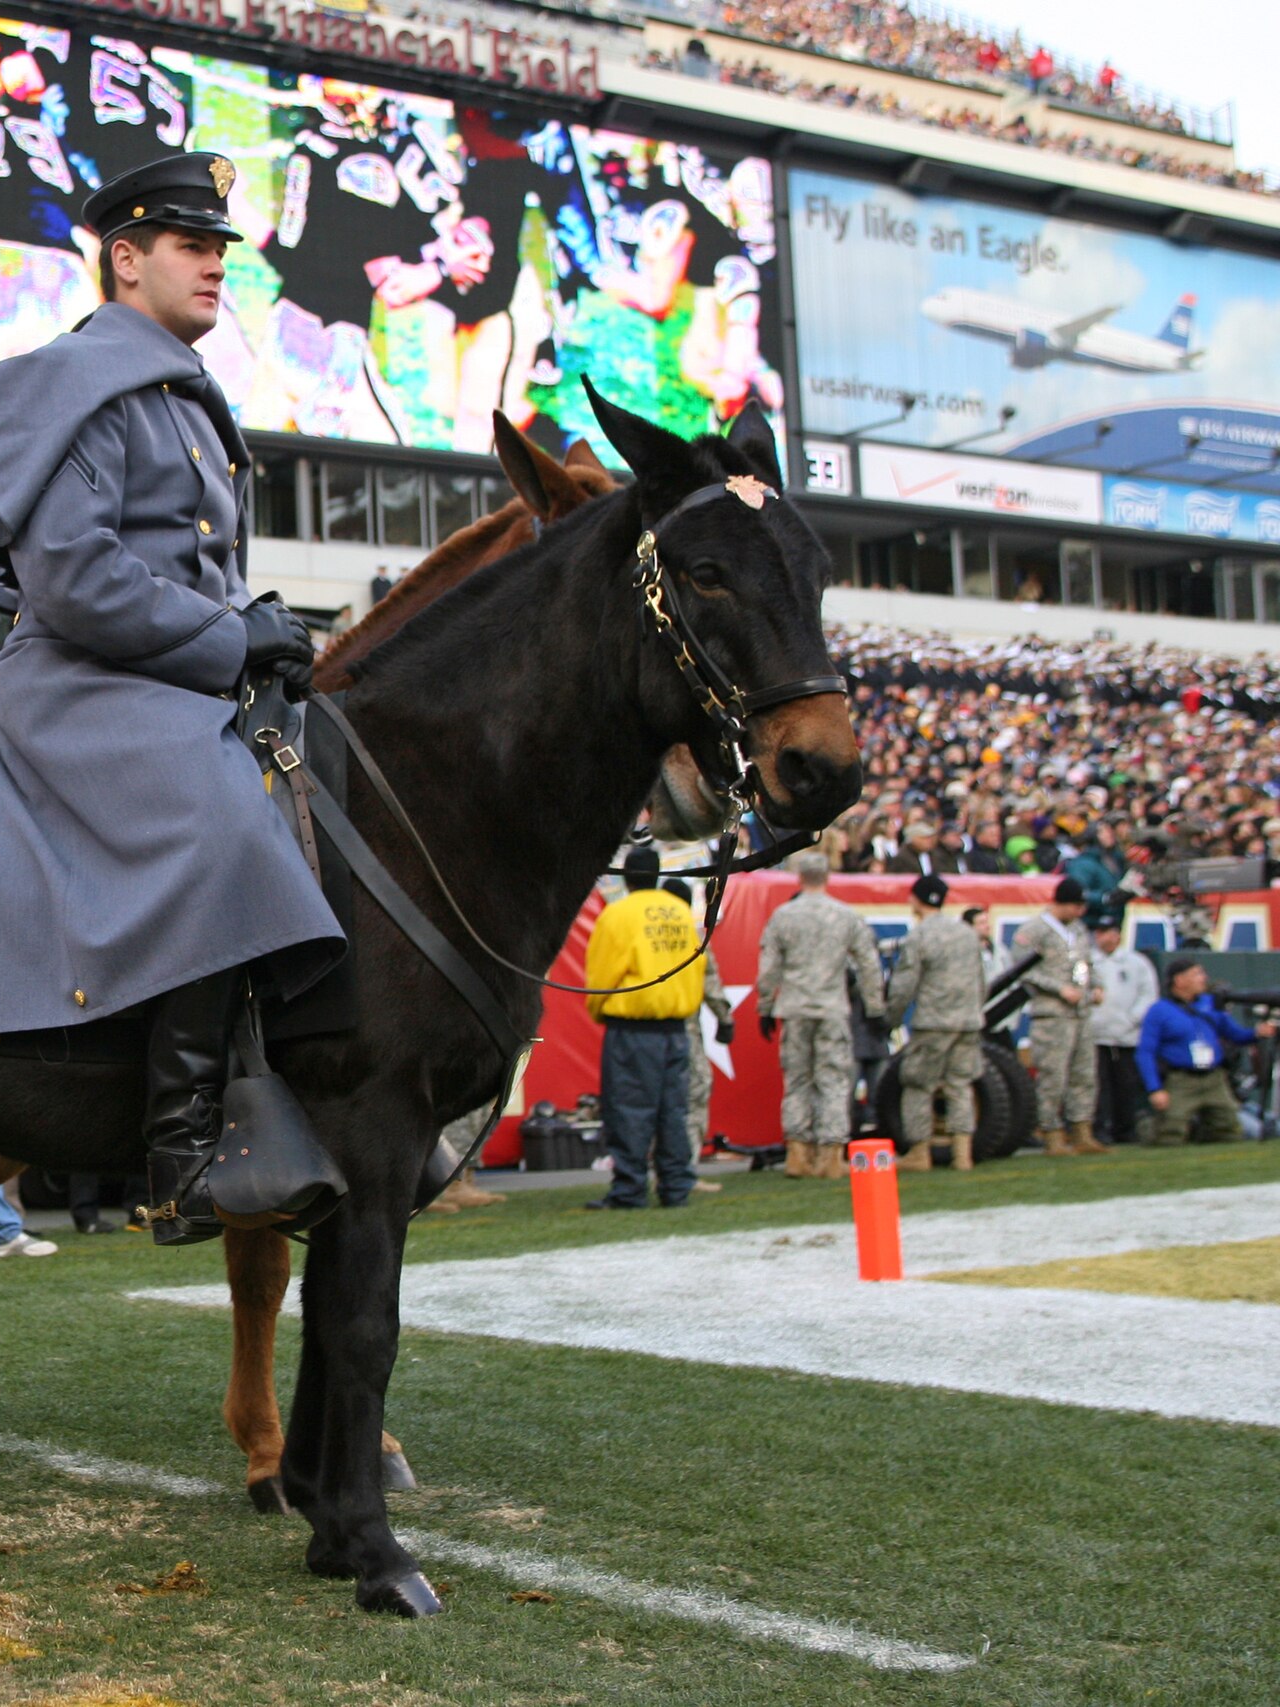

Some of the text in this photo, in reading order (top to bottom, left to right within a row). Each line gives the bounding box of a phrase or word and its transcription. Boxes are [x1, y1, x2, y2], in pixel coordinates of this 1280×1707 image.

[230, 0, 477, 77] Financial
[482, 28, 604, 100] Field
[804, 194, 1070, 275] Fly like an Eagle.
[644, 905, 684, 922] CSC
